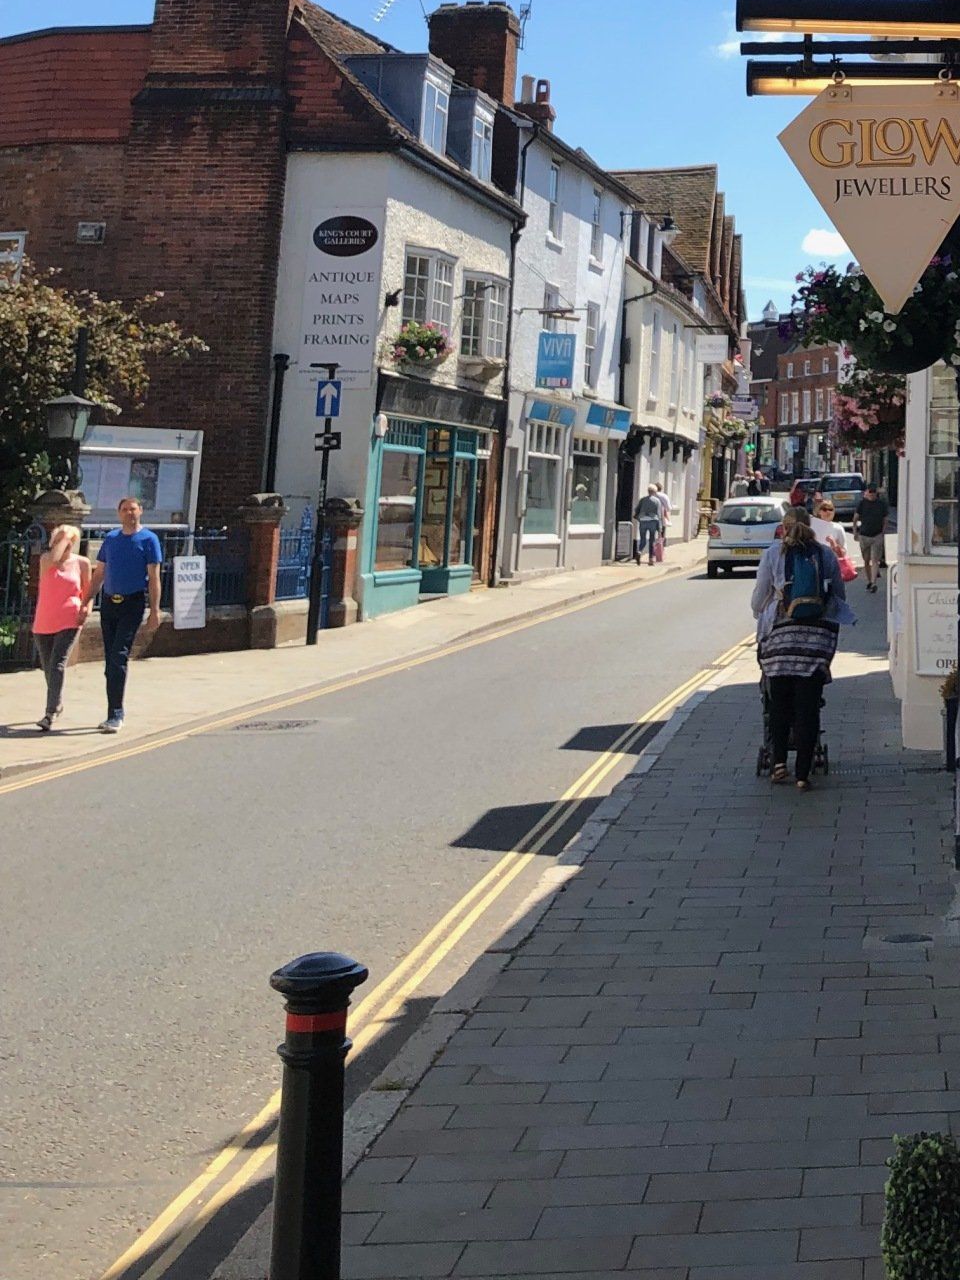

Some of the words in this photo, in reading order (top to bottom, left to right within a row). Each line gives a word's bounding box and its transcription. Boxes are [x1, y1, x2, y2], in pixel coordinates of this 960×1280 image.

[833, 176, 952, 204] JEWELLERS
[345, 230, 373, 238] COURT
[308, 271, 375, 284] ANTIQUE
[320, 293, 360, 305] MAPS
[312, 314, 364, 326] PRINTS
[303, 334, 370, 346] FRAMING
